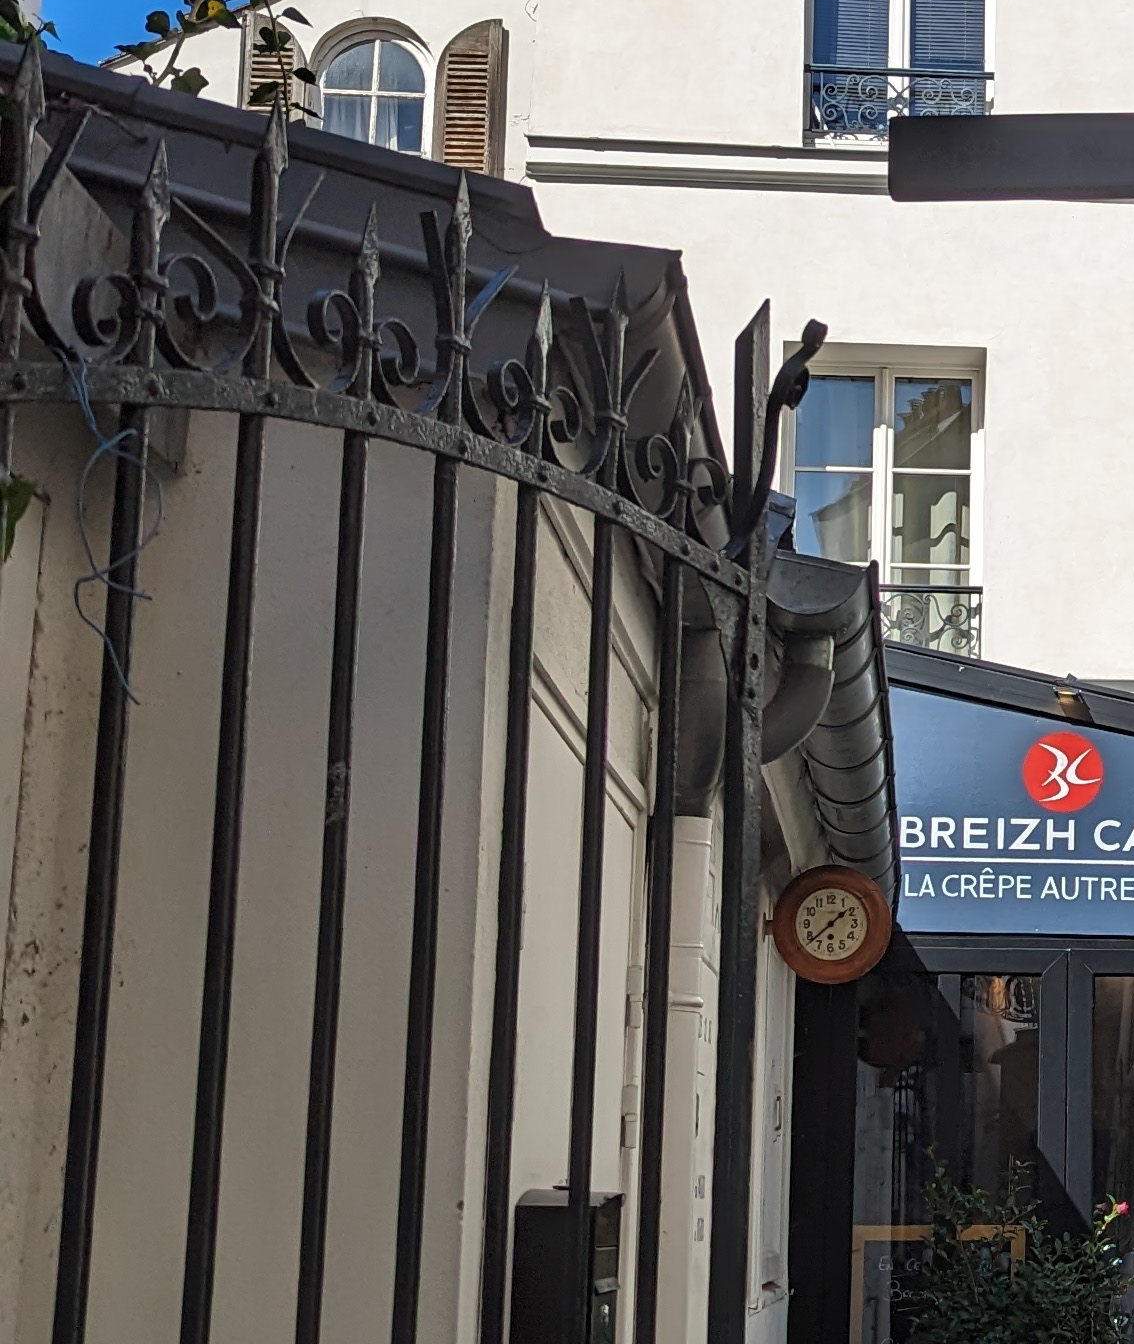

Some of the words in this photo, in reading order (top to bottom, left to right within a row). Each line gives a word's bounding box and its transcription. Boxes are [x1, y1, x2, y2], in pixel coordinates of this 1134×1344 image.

[900, 816, 1076, 851] BREIZH
[904, 873, 936, 898] LA
[941, 867, 1032, 900] CRÊPE
[815, 897, 823, 908] 11
[826, 895, 837, 905] 12
[806, 906, 816, 917] 10
[848, 907, 856, 916] 2
[803, 918, 811, 929] 9
[850, 918, 858, 929] 3
[846, 931, 855, 941] 4
[815, 940, 823, 950] 7
[826, 942, 834, 953] 6
[838, 940, 846, 950] 5
